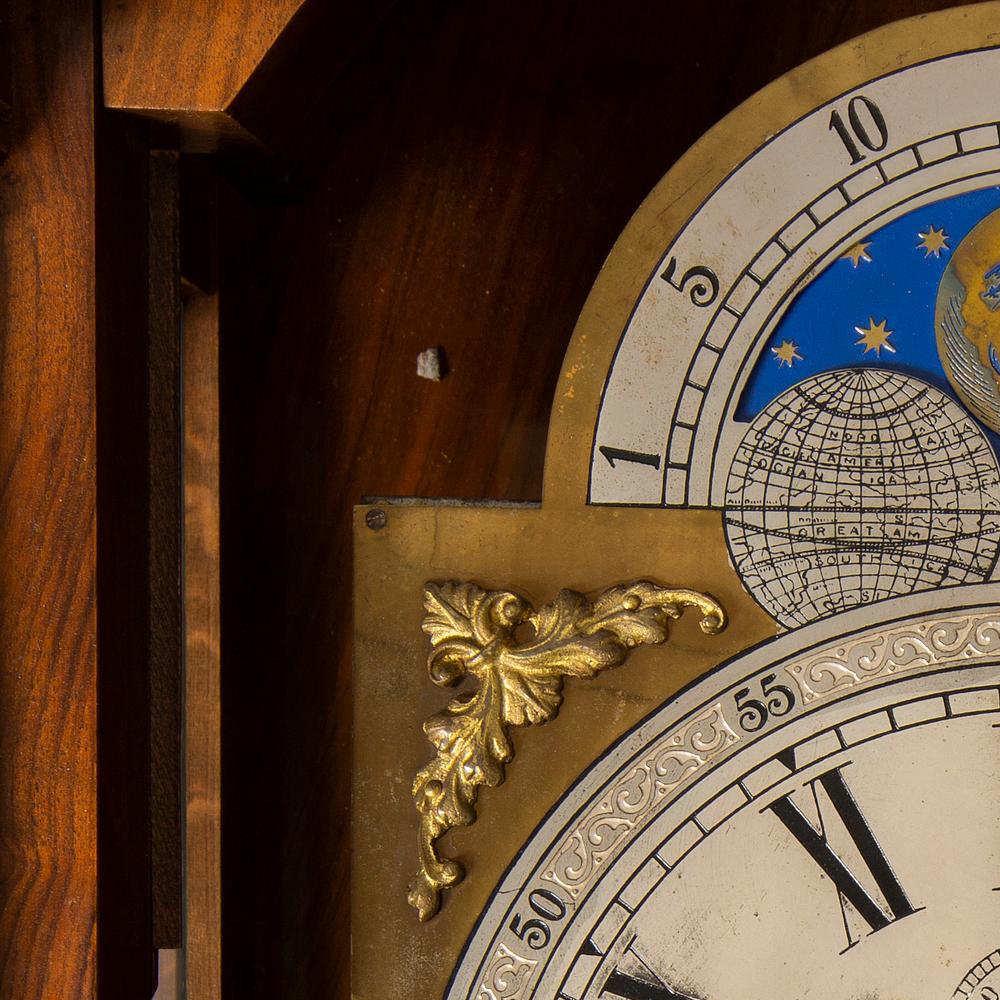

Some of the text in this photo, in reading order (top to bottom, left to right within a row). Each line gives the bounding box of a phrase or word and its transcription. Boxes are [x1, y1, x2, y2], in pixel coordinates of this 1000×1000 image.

[828, 95, 889, 166] 10
[659, 256, 720, 308] 5
[598, 445, 662, 471] 1
[733, 672, 796, 733] 55
[760, 760, 927, 955] XI
[508, 888, 567, 951] 50
